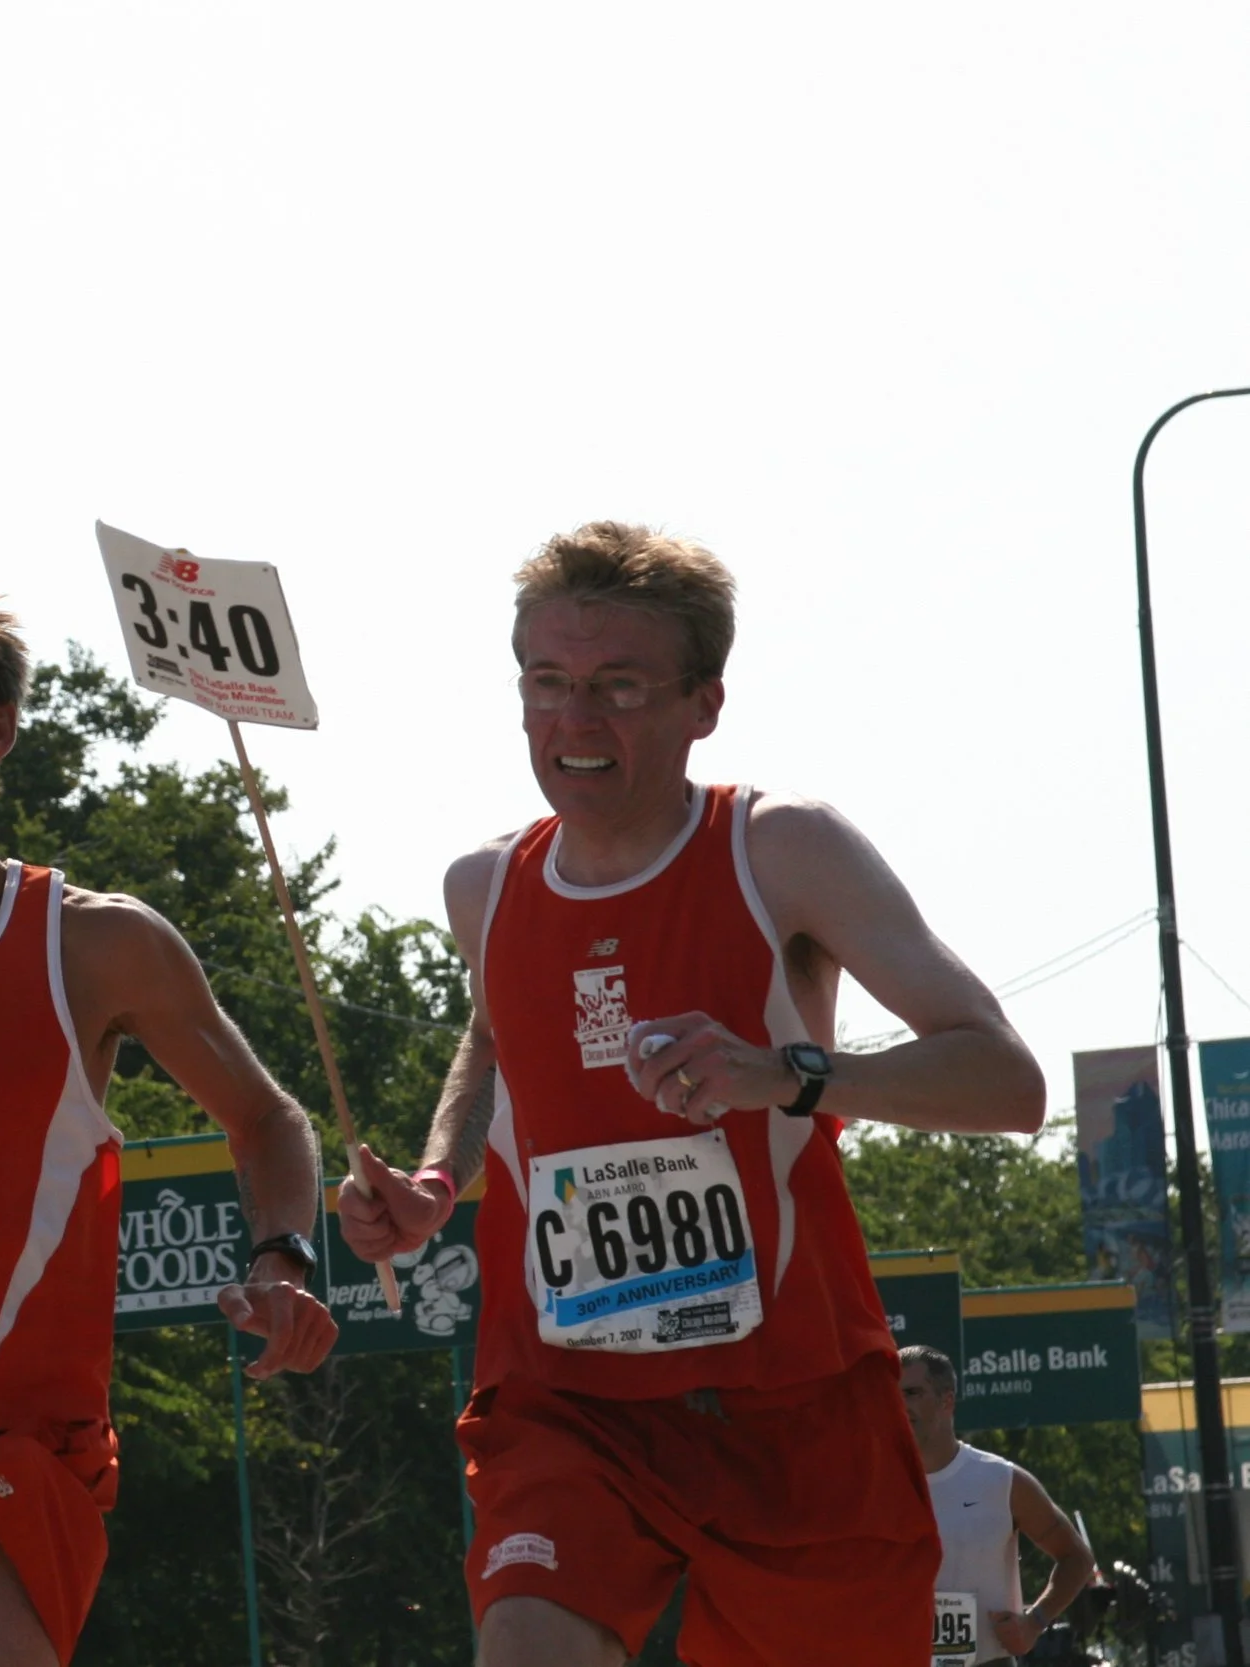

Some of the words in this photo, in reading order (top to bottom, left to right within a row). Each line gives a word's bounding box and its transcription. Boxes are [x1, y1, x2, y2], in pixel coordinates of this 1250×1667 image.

[121, 572, 280, 678] 3:40
[262, 708, 296, 720] TEAM
[583, 1157, 650, 1184] LaSalle
[654, 1154, 699, 1173] Bank
[587, 1188, 611, 1201] ABN
[613, 1182, 647, 1196] AMRO
[535, 1209, 574, 1288] C
[586, 1184, 747, 1280] 6980
[577, 1295, 611, 1317] 30th
[616, 1262, 742, 1307] ANNIVERSARY
[567, 1331, 607, 1347] October
[620, 1328, 643, 1342] 2007
[962, 1349, 1042, 1376] aSalle
[1047, 1344, 1109, 1370] Bank
[990, 1379, 1033, 1395] AMRO
